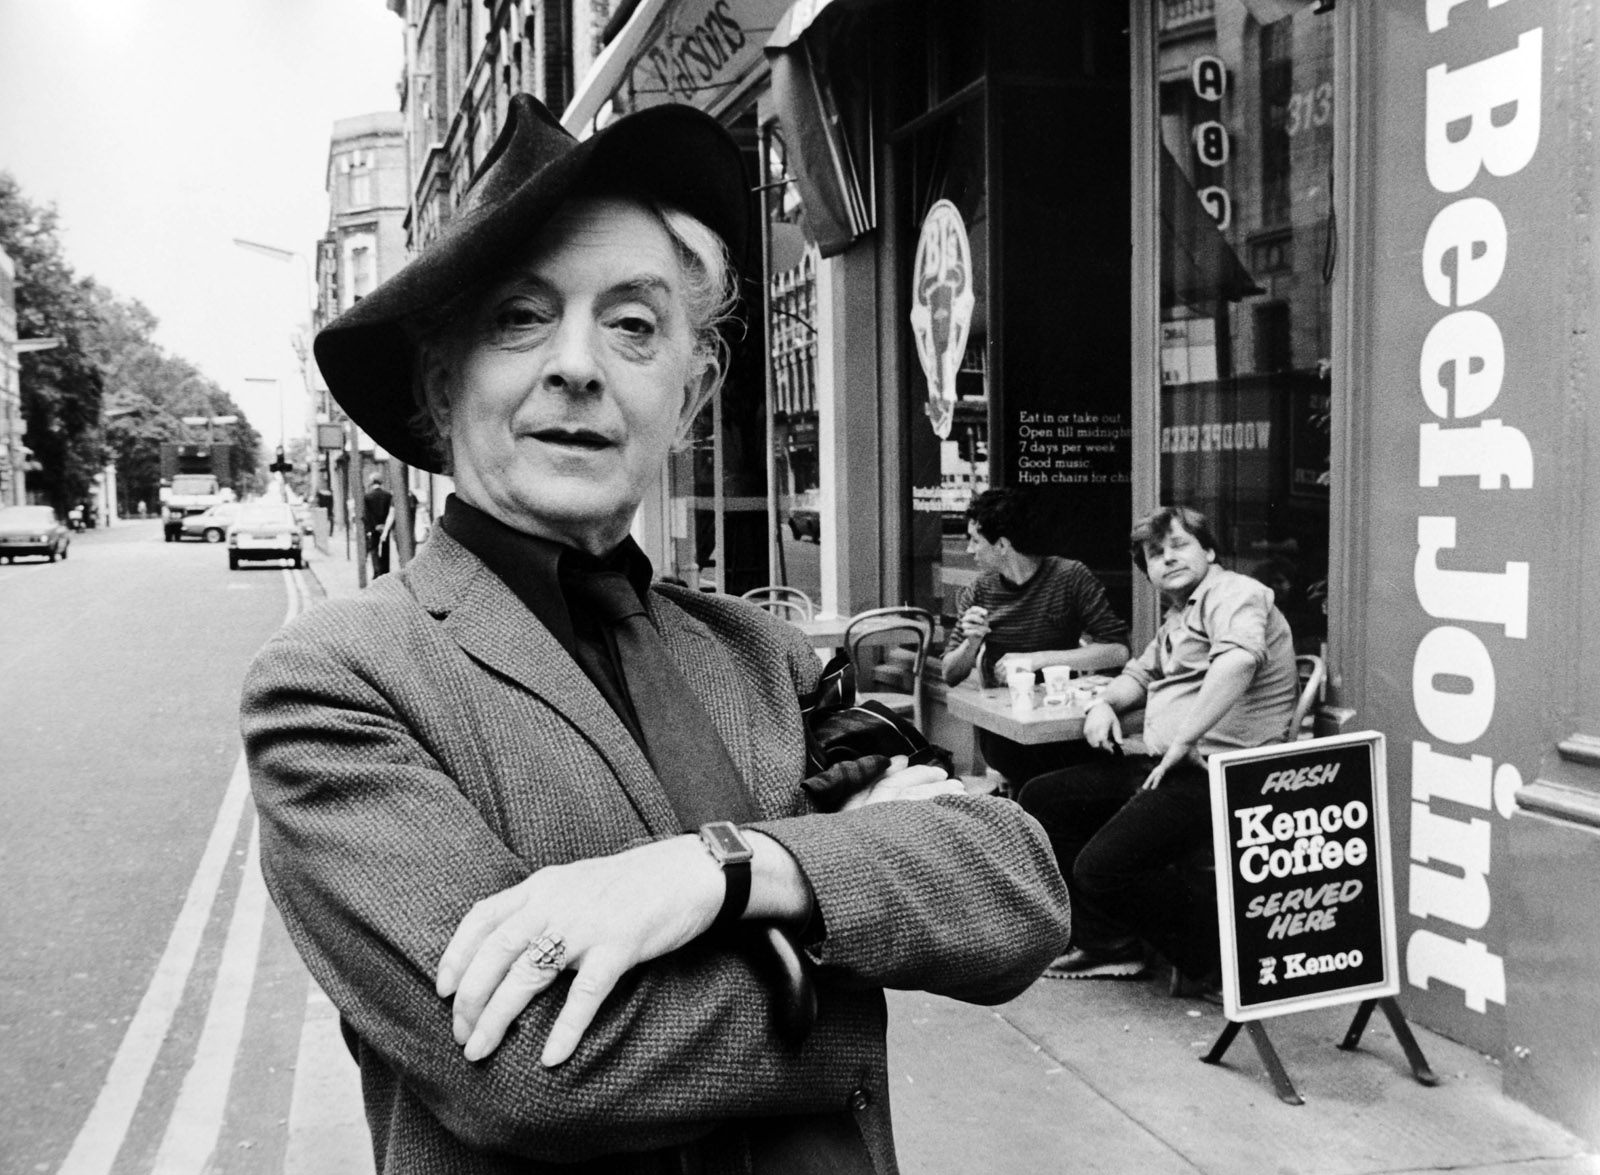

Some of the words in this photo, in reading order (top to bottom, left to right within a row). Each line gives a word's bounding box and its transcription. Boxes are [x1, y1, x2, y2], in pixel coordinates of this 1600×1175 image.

[1418, 26, 1543, 489] Beef
[1018, 425, 1053, 440] Open
[1057, 425, 1073, 437] till
[1019, 410, 1039, 423] Eat
[1043, 411, 1054, 423] in
[1057, 413, 1069, 423] or
[1073, 411, 1099, 423] take
[1101, 412, 1120, 423] out
[1018, 455, 1051, 468] Good
[1055, 457, 1089, 468] music
[1019, 440, 1027, 453] 7
[1030, 440, 1059, 455] days
[1062, 444, 1081, 455] per
[1084, 441, 1116, 453] week
[1018, 470, 1048, 486] High
[1051, 470, 1088, 483] chairs
[1091, 470, 1106, 483] for
[1260, 762, 1341, 795] FRESH
[1406, 515, 1530, 1014] Joint
[1234, 800, 1368, 848] Kenco
[1239, 835, 1368, 883] Coffee
[1245, 879, 1363, 919] SERVED
[1267, 906, 1338, 940] HERE
[1282, 949, 1364, 979] Kenco
